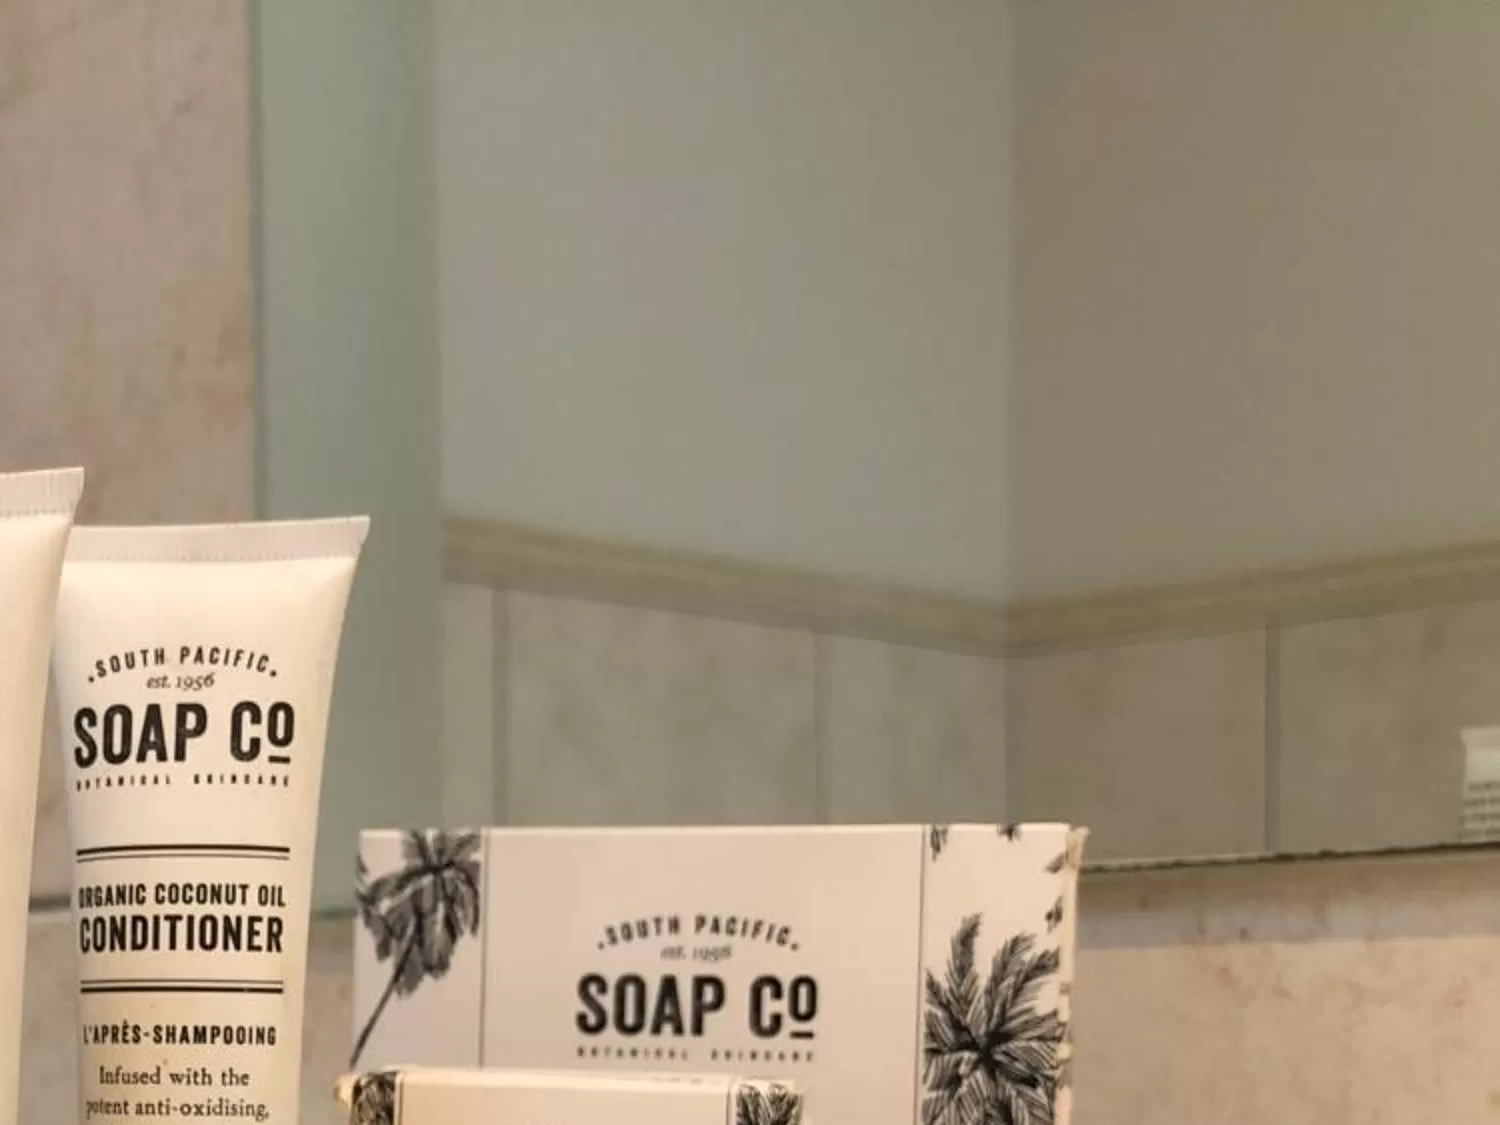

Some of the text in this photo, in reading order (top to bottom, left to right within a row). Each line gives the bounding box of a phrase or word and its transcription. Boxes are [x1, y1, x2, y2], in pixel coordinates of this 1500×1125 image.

[95, 646, 270, 677] SOUTH PACIFIC
[147, 673, 215, 691] est. 1956
[73, 702, 208, 768] SOAP
[79, 883, 286, 909] ORGANIC COCONUT OIL
[79, 914, 284, 953] CONDITIONER
[605, 915, 792, 946] SOUTH PACIFIC
[575, 972, 726, 1037] SOAP
[99, 1066, 250, 1087] Infused with the
[86, 1098, 270, 1122] potent anti-oxidising,
